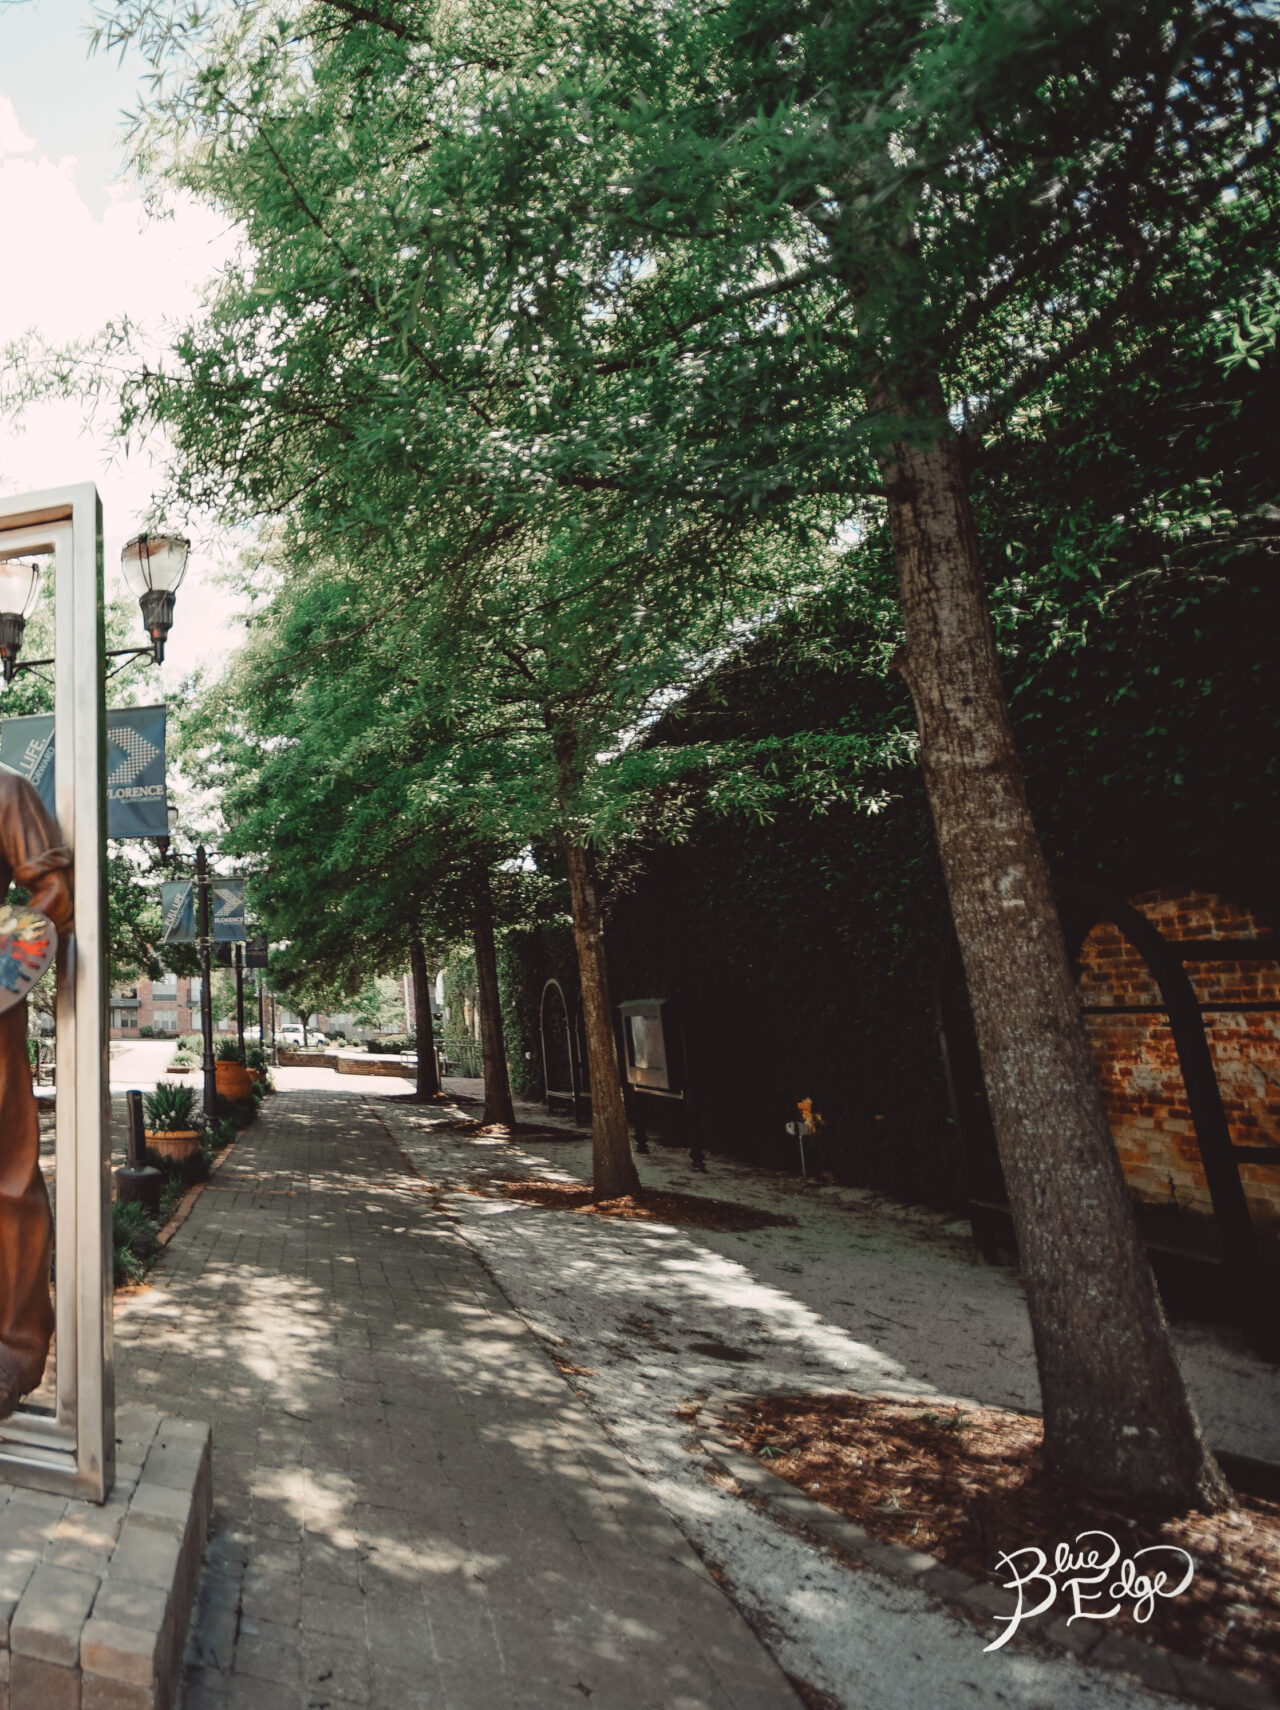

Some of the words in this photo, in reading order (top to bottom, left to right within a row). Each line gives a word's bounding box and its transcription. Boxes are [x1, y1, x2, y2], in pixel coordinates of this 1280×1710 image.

[19, 738, 46, 770] LIFE.
[31, 746, 55, 786] ORWARD
[106, 784, 164, 800] LORENCE
